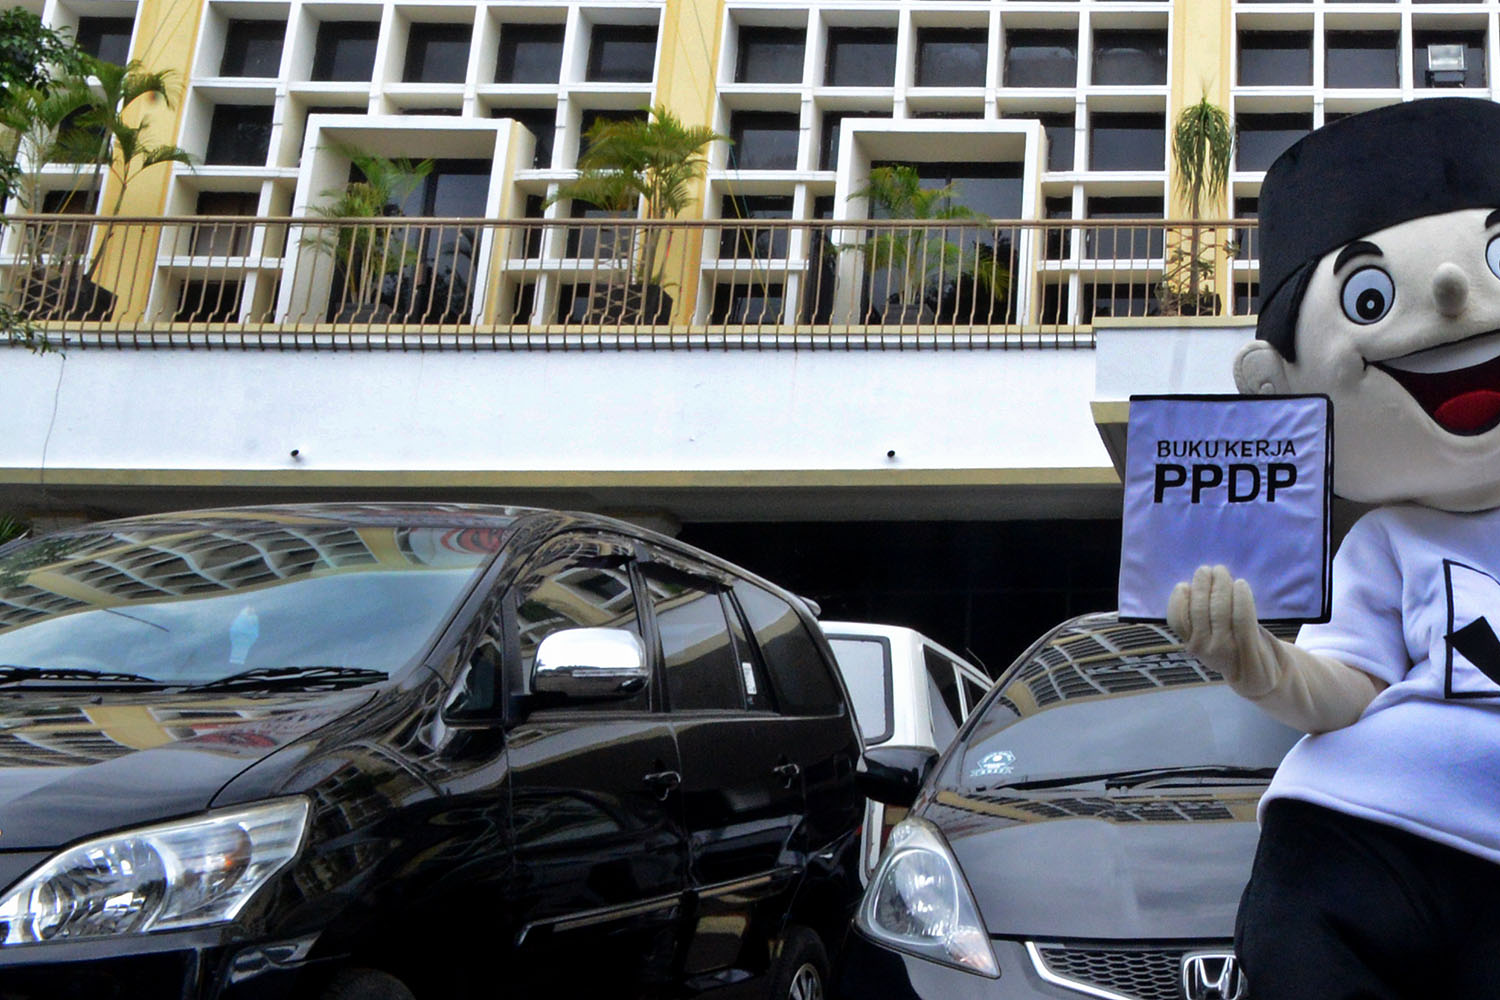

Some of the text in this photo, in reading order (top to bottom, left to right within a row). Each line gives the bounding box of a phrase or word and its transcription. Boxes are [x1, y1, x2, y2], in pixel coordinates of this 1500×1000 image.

[1156, 440, 1296, 458] BUKU KERJA
[1153, 462, 1298, 504] PPDP
